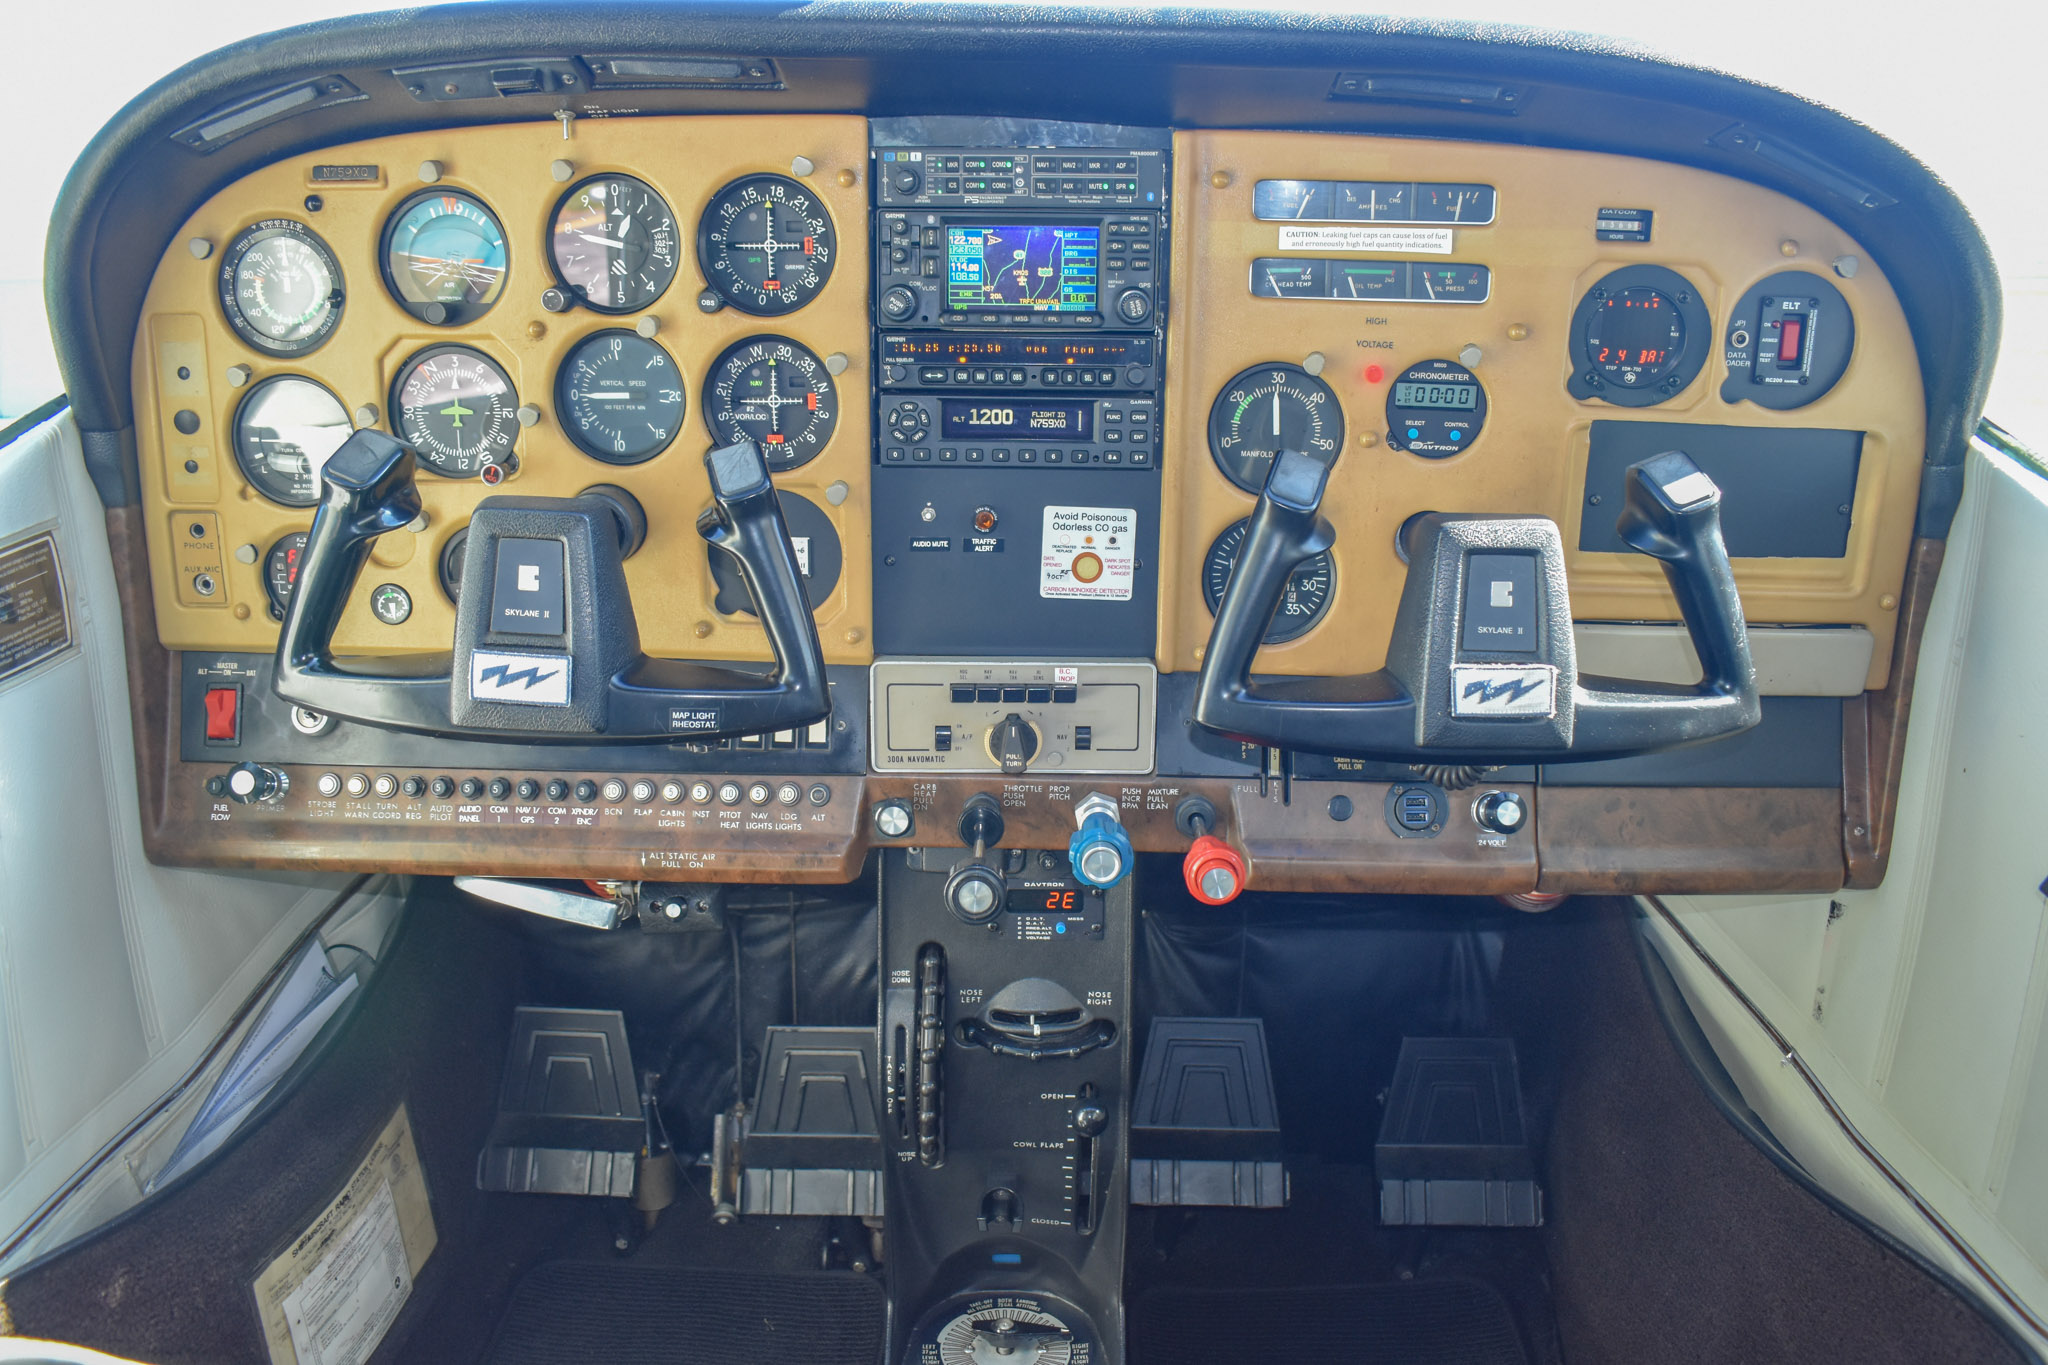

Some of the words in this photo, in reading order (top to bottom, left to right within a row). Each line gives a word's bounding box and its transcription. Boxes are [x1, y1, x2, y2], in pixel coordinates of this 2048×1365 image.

[1062, 161, 1076, 169] NAV2
[322, 166, 369, 179] N759XQ
[741, 187, 758, 202] 15
[770, 186, 784, 198] 18
[598, 223, 613, 232] ALT
[1286, 231, 1321, 239] CAUTION:
[1322, 232, 1348, 240] Leaking
[1349, 231, 1362, 239] fuel
[1363, 233, 1378, 241] caps
[1435, 232, 1448, 241] fuel
[949, 236, 982, 245] 122.700
[1132, 242, 1150, 250] MENU
[1305, 241, 1345, 249] erroneously
[1346, 241, 1361, 249] high
[1361, 241, 1375, 249] fuel
[1376, 242, 1404, 250] quantity
[949, 246, 982, 254] 123.050
[951, 272, 980, 281] 108.50
[1782, 302, 1800, 310] ELT
[1366, 317, 1388, 325] HIGH
[610, 339, 622, 350] 10
[1356, 340, 1394, 349] VOLTAGE
[1271, 372, 1286, 384] 30
[1409, 371, 1469, 381] CHRONOMETER
[1229, 391, 1245, 403] 20
[1308, 391, 1325, 404] 40
[1415, 387, 1469, 404] 00:00
[968, 408, 1014, 425] 1200
[1320, 439, 1334, 450] 50
[1053, 512, 1079, 520] Avoid
[1081, 512, 1128, 522] Poisonous
[1052, 521, 1092, 531] Odorless
[1094, 523, 1110, 532] CO
[1111, 526, 1128, 534] gas
[183, 542, 215, 550] PHONE
[913, 540, 930, 549] AUDIO
[930, 540, 948, 549] MUTE
[971, 537, 997, 547] TRAFFIC
[974, 545, 994, 553] ALERT
[1301, 580, 1317, 591] 30
[505, 608, 540, 618] SKYLANE
[1285, 604, 1300, 614] 35
[1477, 626, 1513, 635] SKYLANE
[672, 712, 690, 720] MAP
[692, 712, 716, 721] LIGHT
[672, 720, 716, 729] RHEOSTAT
[887, 755, 905, 763] 300A
[907, 755, 945, 763] NAVOMATIC
[1003, 785, 1043, 793] THROTTLE
[1049, 785, 1070, 793] PROP
[1122, 788, 1142, 796] PUSH
[1148, 788, 1179, 796] MIXTURE
[1003, 792, 1024, 800] PUSH
[1122, 795, 1141, 803] INCR
[1147, 795, 1165, 803] PULL
[308, 801, 337, 809] STROBE
[1003, 799, 1026, 807] OPEN
[1122, 802, 1139, 810] RPM
[1147, 802, 1169, 810] LEAN
[213, 804, 229, 812] FUEL
[430, 805, 453, 813] AUTO
[459, 805, 481, 813] AUDIO
[490, 806, 508, 814] COM
[604, 808, 623, 816] BCN
[634, 808, 653, 816] FLAP
[211, 813, 231, 821] FLOW
[373, 812, 401, 820] COORD
[430, 813, 452, 821] PILOT
[660, 810, 685, 818] CABIN
[692, 810, 710, 818] INST
[719, 811, 741, 819] PITOT
[752, 812, 768, 820] NAV
[780, 812, 797, 821] LDG
[811, 814, 825, 822] ALT
[459, 815, 480, 823] PANEL
[521, 815, 535, 824] GPS
[576, 817, 592, 825] ENC
[658, 820, 685, 828] LIGHTS
[720, 821, 740, 829] HEAT
[746, 822, 773, 830] LIGHTS
[775, 823, 802, 831] LIGHTS
[1487, 839, 1505, 847] VOLT
[649, 853, 665, 861] ALT
[668, 853, 697, 861] STATIC
[701, 853, 716, 861] AIR
[661, 861, 681, 869] PULL
[689, 861, 704, 869] ON
[1031, 1217, 1060, 1225] CLOSED
